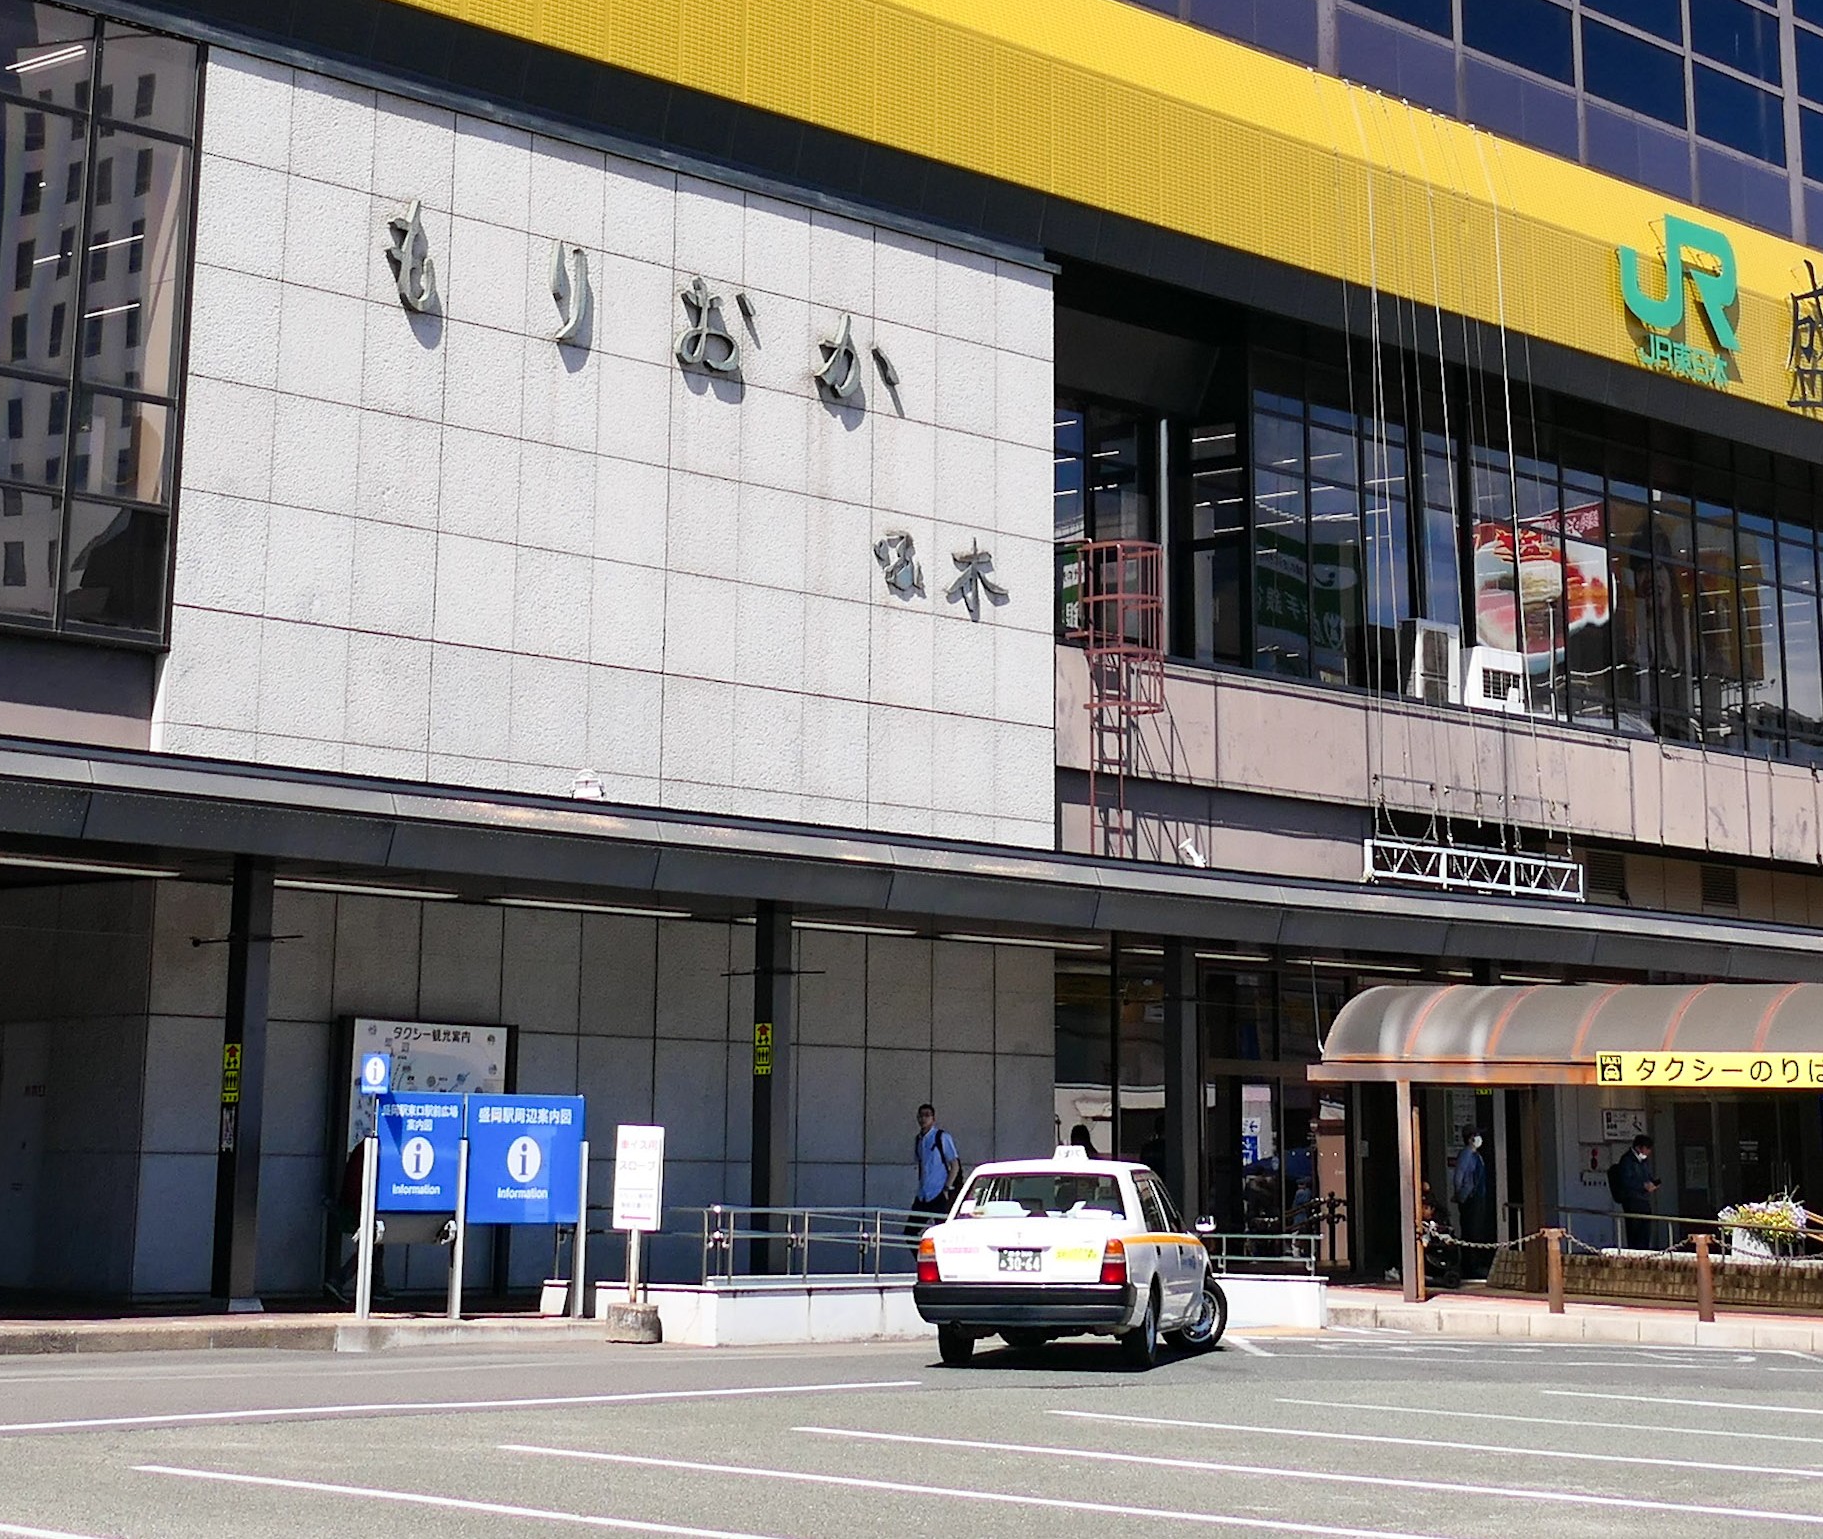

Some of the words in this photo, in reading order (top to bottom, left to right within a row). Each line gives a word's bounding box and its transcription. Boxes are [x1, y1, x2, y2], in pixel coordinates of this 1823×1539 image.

[1619, 214, 1738, 352] JR
[384, 198, 906, 402] もりおか
[1640, 334, 1730, 390] JR東日本
[393, 1024, 472, 1044] タクシー観光案内
[478, 1106, 573, 1125] 盛岡駅周辺案内図
[406, 1119, 434, 1132] 案内図
[391, 1184, 441, 1196] Information
[497, 1186, 550, 1201] Information
